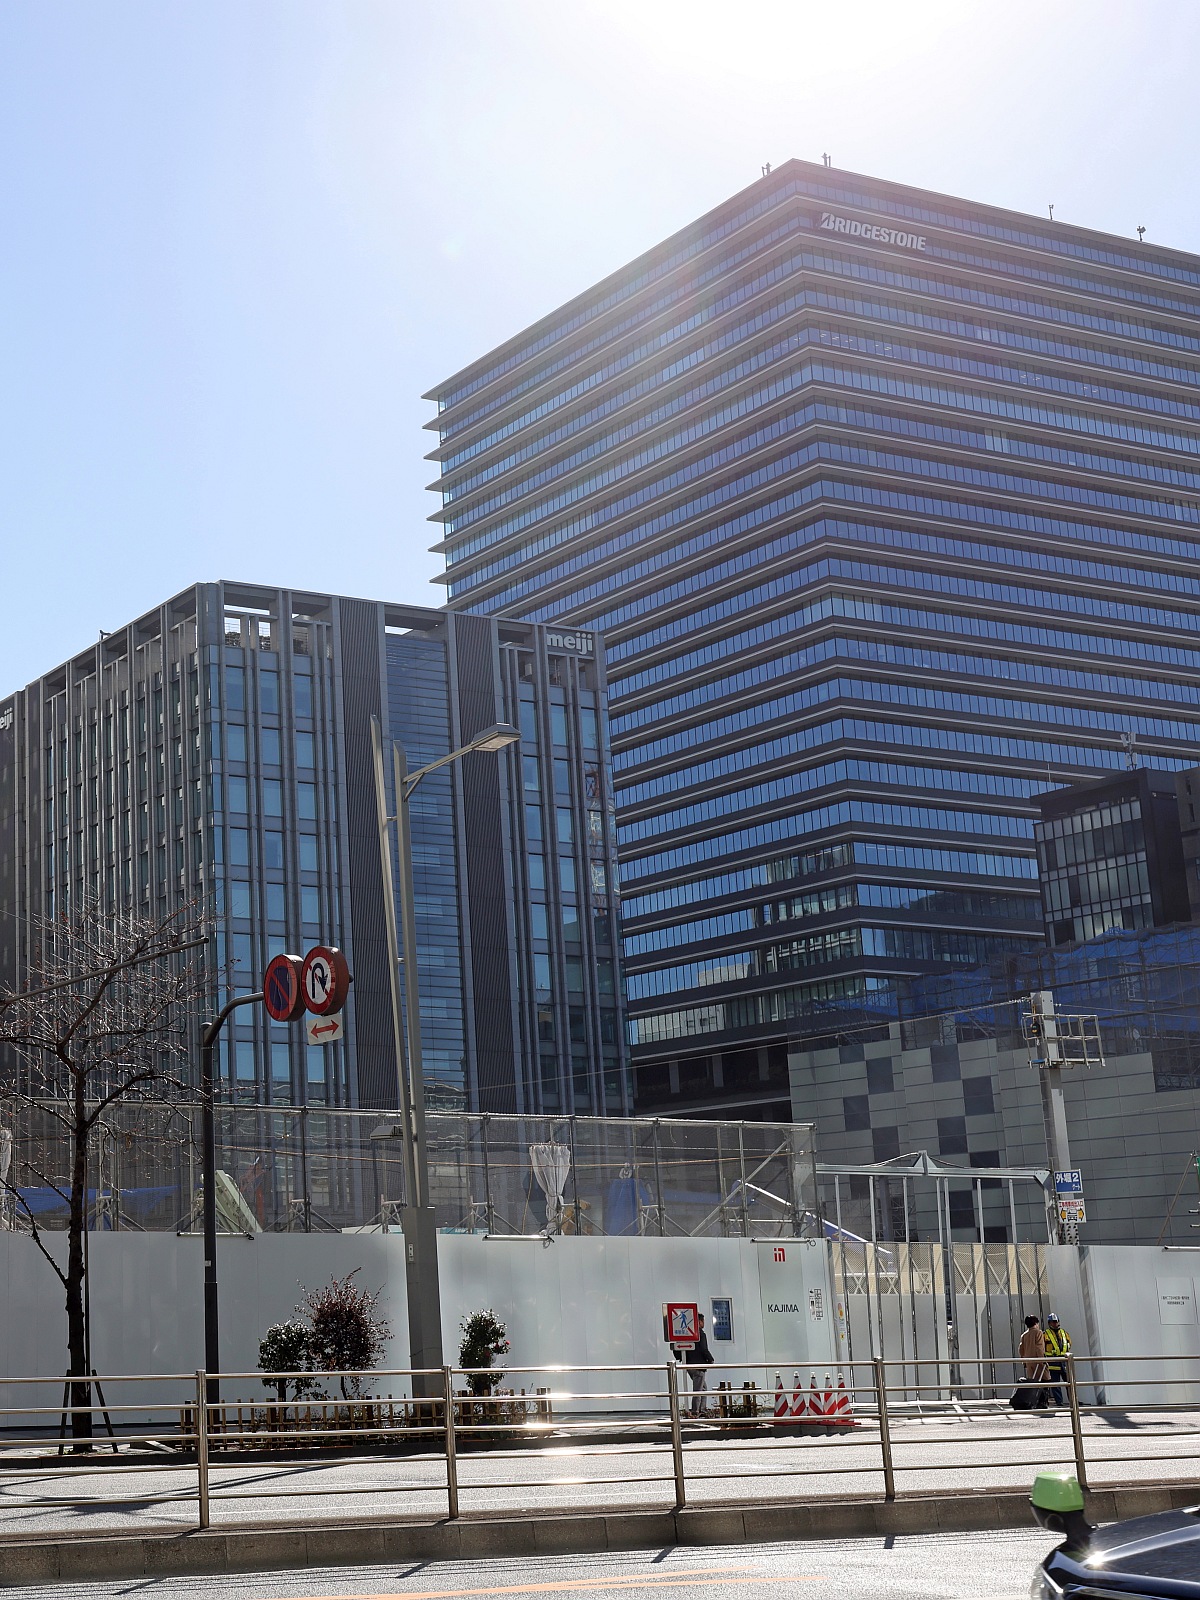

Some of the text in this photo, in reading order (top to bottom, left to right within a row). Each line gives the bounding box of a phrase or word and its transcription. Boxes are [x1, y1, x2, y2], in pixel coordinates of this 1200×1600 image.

[820, 212, 927, 251] BRIDGESTONE
[546, 632, 593, 655] meiji
[767, 1304, 799, 1313] KAJIMA
